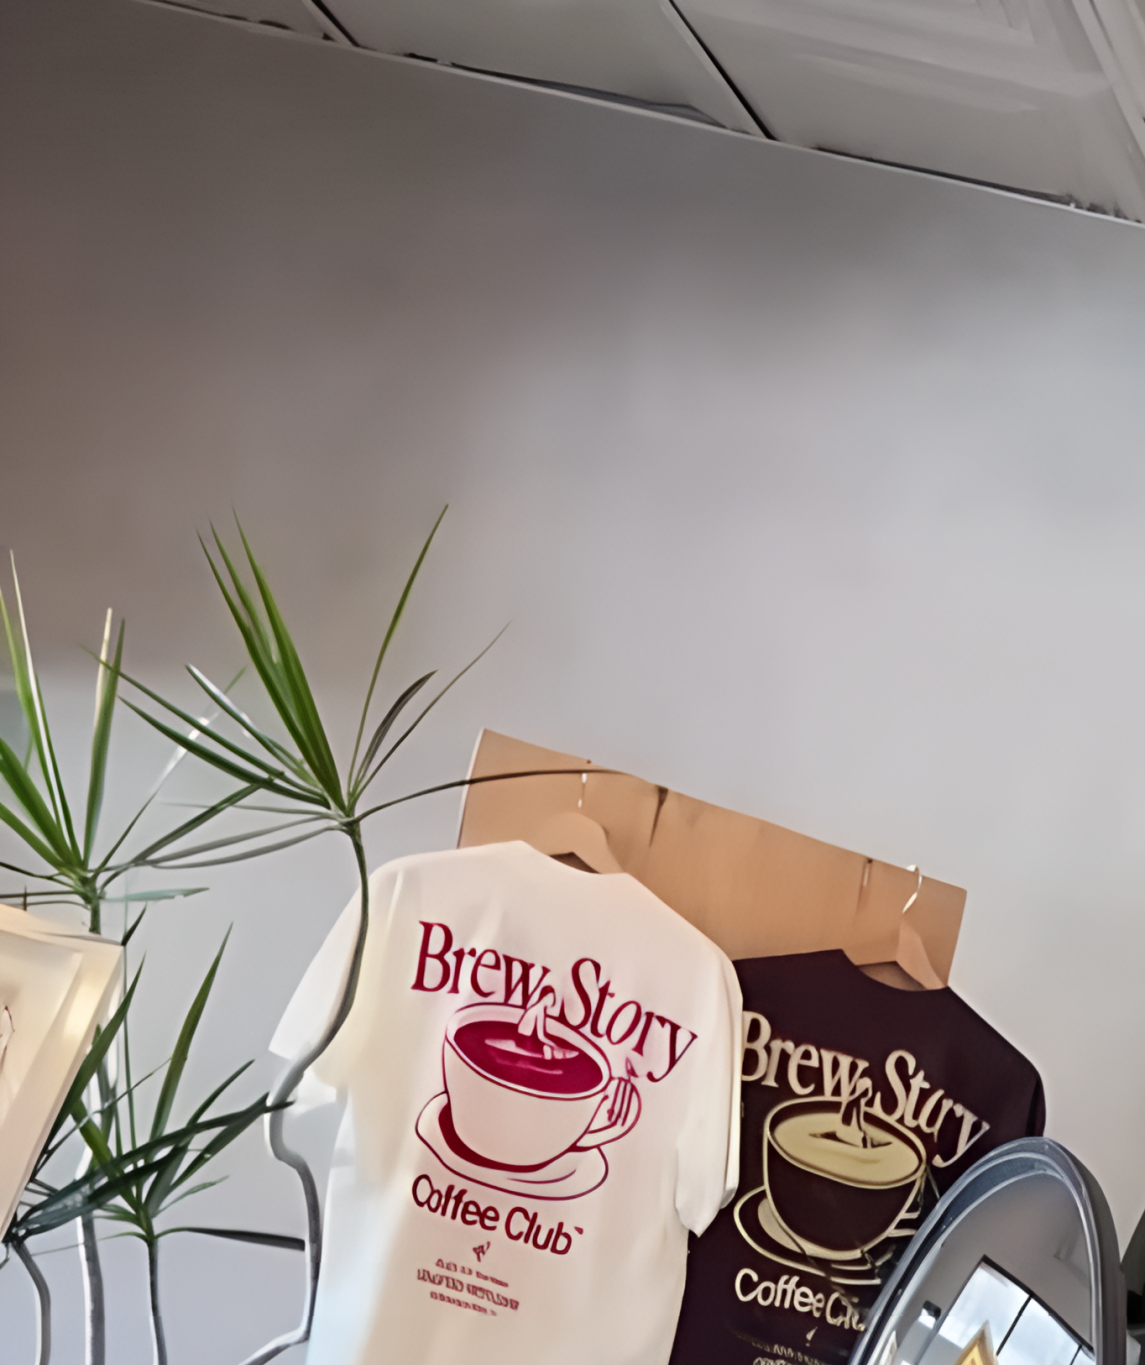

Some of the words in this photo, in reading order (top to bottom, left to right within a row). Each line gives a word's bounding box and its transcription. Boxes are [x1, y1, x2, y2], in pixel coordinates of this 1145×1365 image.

[411, 920, 551, 1008] Brew
[559, 958, 698, 1082] Story
[741, 1010, 869, 1099] Brew
[412, 1174, 499, 1231] Coffee
[735, 1268, 825, 1317] Coffee
